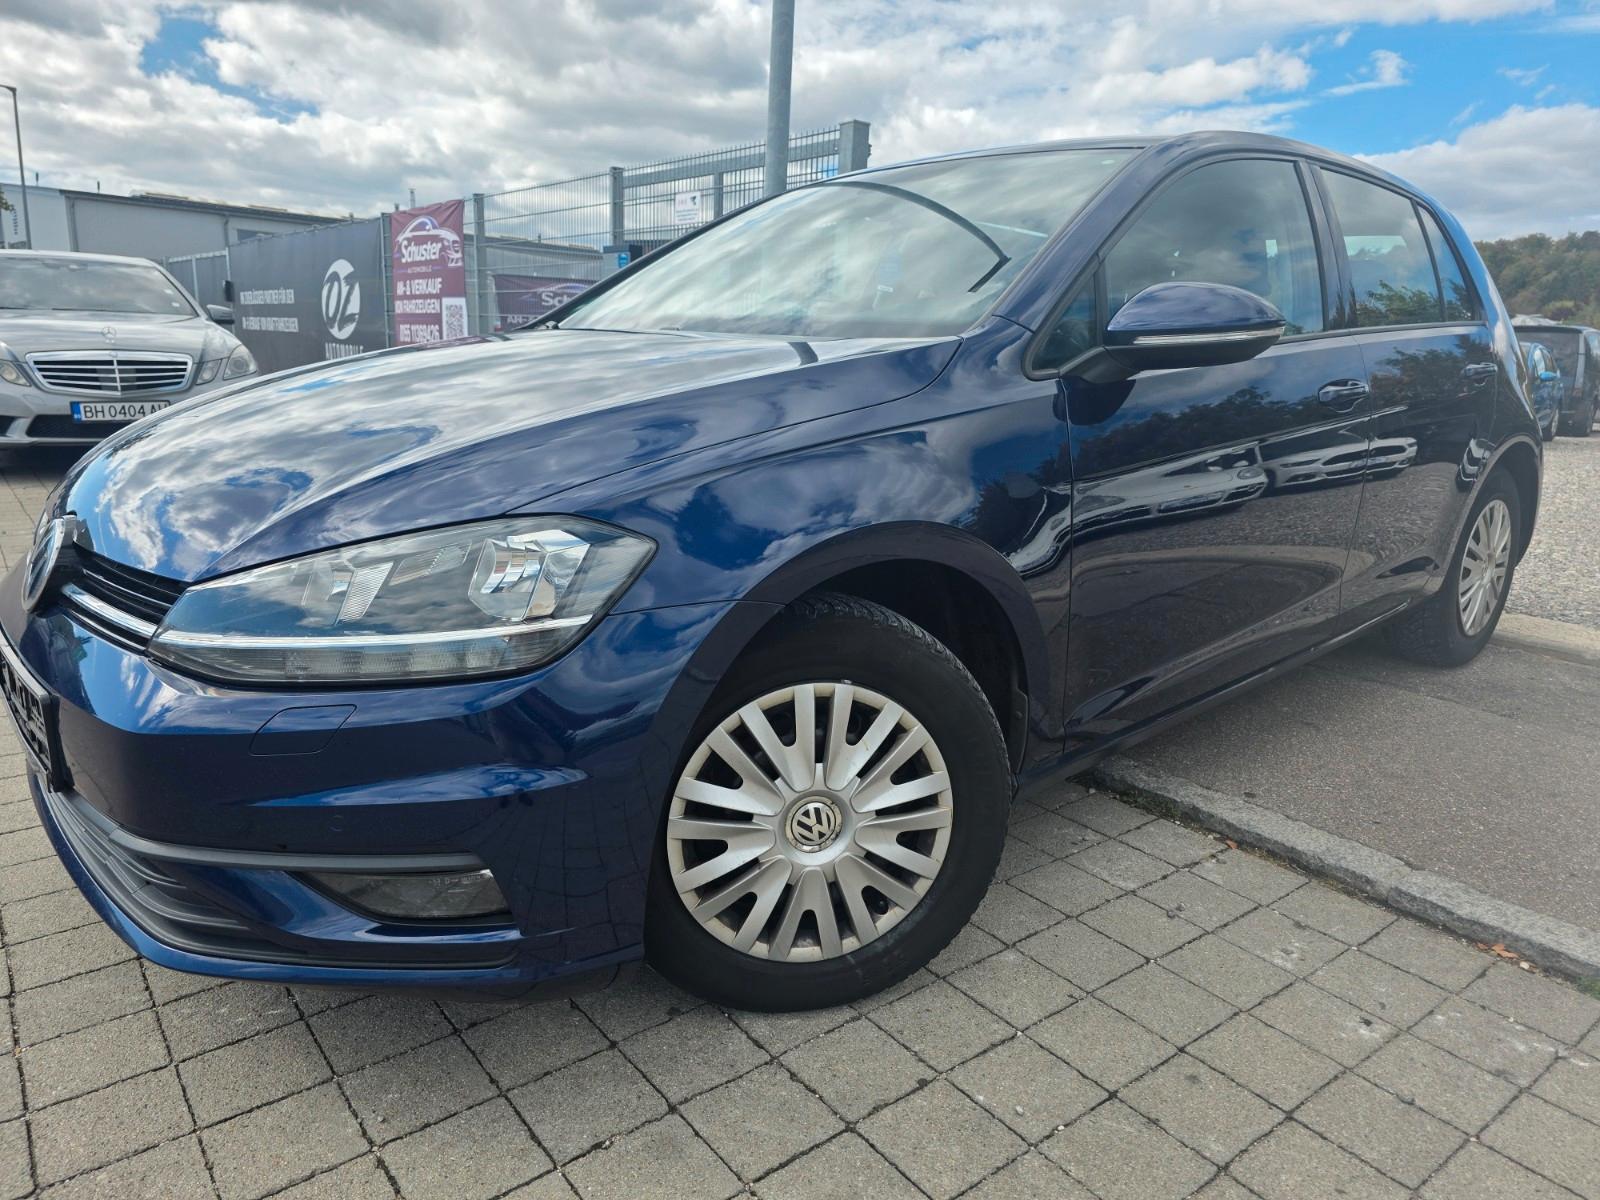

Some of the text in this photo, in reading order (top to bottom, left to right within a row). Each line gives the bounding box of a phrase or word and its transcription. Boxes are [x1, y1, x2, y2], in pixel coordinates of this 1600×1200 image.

[400, 240, 442, 263] Schuster
[83, 404, 105, 419] BH
[108, 404, 146, 418] 0404
